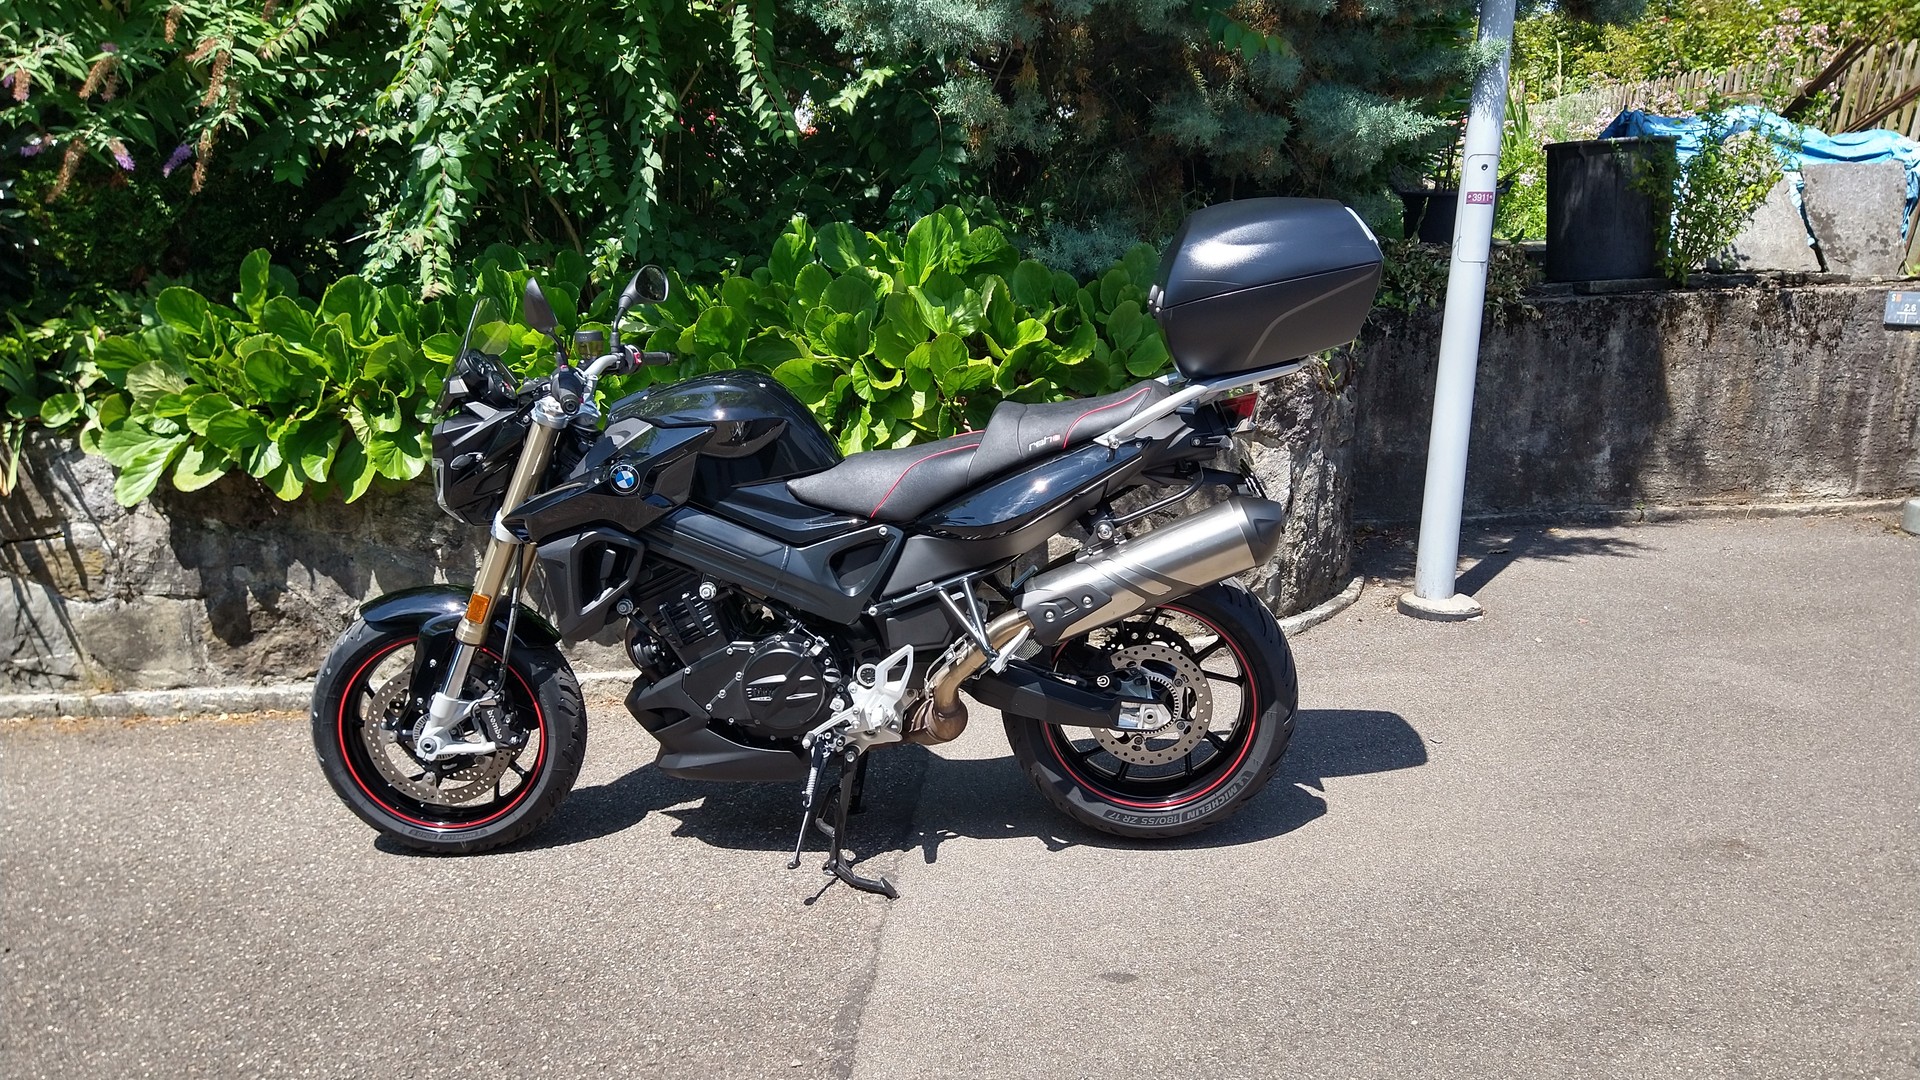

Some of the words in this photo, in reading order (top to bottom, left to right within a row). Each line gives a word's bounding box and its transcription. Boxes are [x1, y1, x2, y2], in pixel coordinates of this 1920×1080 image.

[1472, 193, 1490, 202] 3911
[486, 709, 502, 740] brembo
[1187, 785, 1238, 820] MICHELIN
[1108, 812, 1121, 821] 17
[1122, 815, 1138, 824] ZR
[1141, 813, 1179, 826] 180/55
